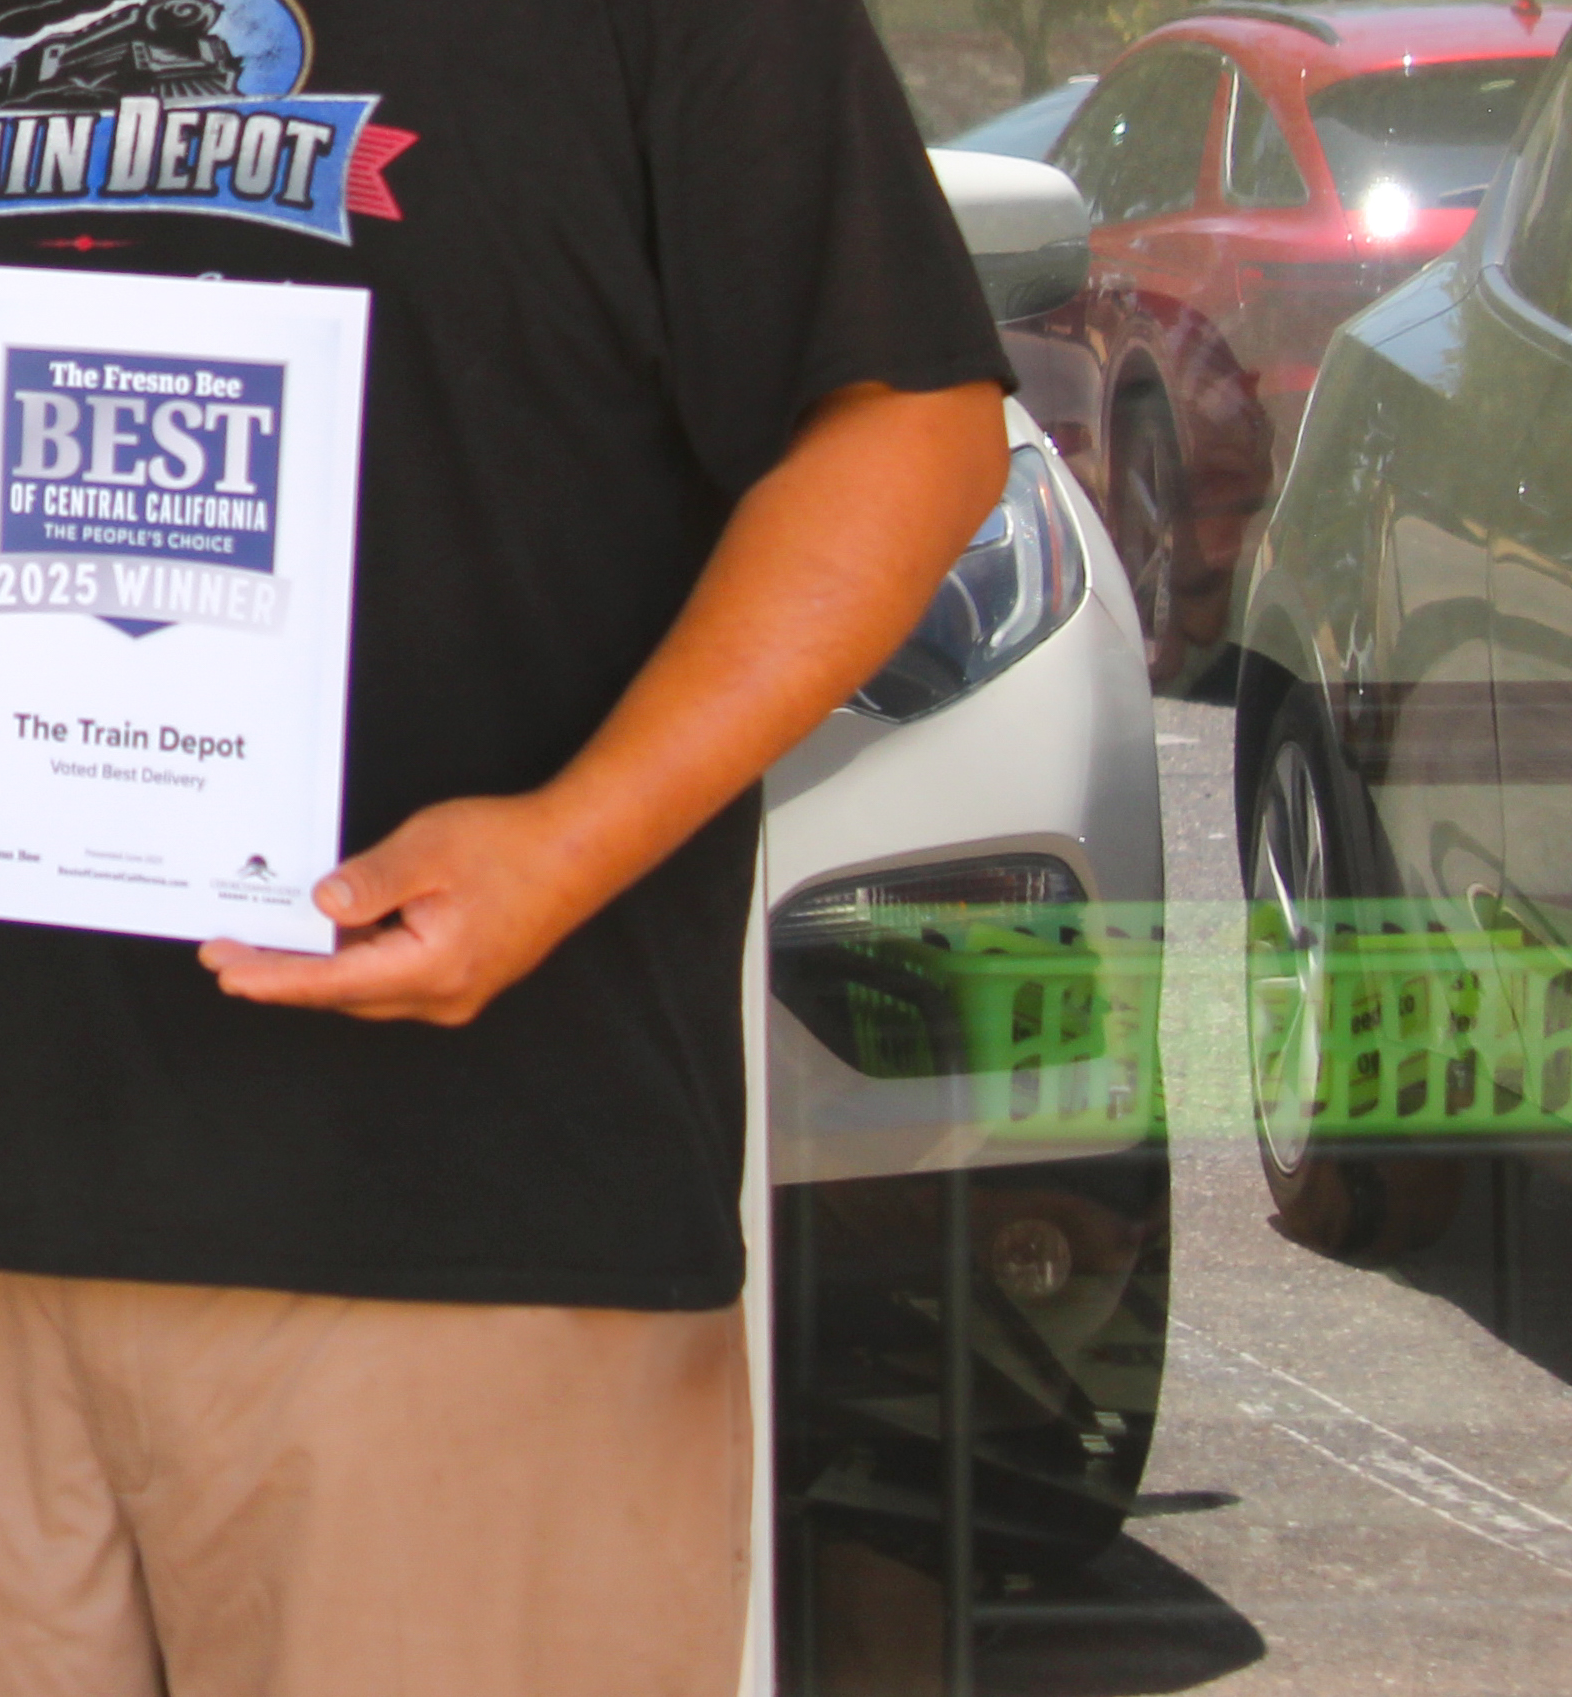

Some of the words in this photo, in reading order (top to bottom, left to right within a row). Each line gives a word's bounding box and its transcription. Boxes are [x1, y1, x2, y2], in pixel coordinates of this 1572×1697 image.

[105, 95, 334, 202] DEPOT
[48, 360, 99, 390] The
[103, 364, 191, 396] Fresno
[194, 369, 244, 399] Bee
[11, 389, 274, 495] BEST
[9, 482, 38, 514] OF
[43, 484, 139, 522] CENTRAL
[145, 491, 268, 532] CALIFORNIA
[44, 522, 77, 541] THE
[82, 525, 164, 549] PEOPLE'S
[166, 532, 236, 554] CHOICE
[111, 562, 277, 627] WINNER
[13, 712, 69, 743] The
[76, 718, 149, 751] Train
[158, 724, 246, 762] Depot
[50, 758, 98, 779] Voted
[101, 763, 138, 783] Best
[141, 767, 206, 792] Delivery
